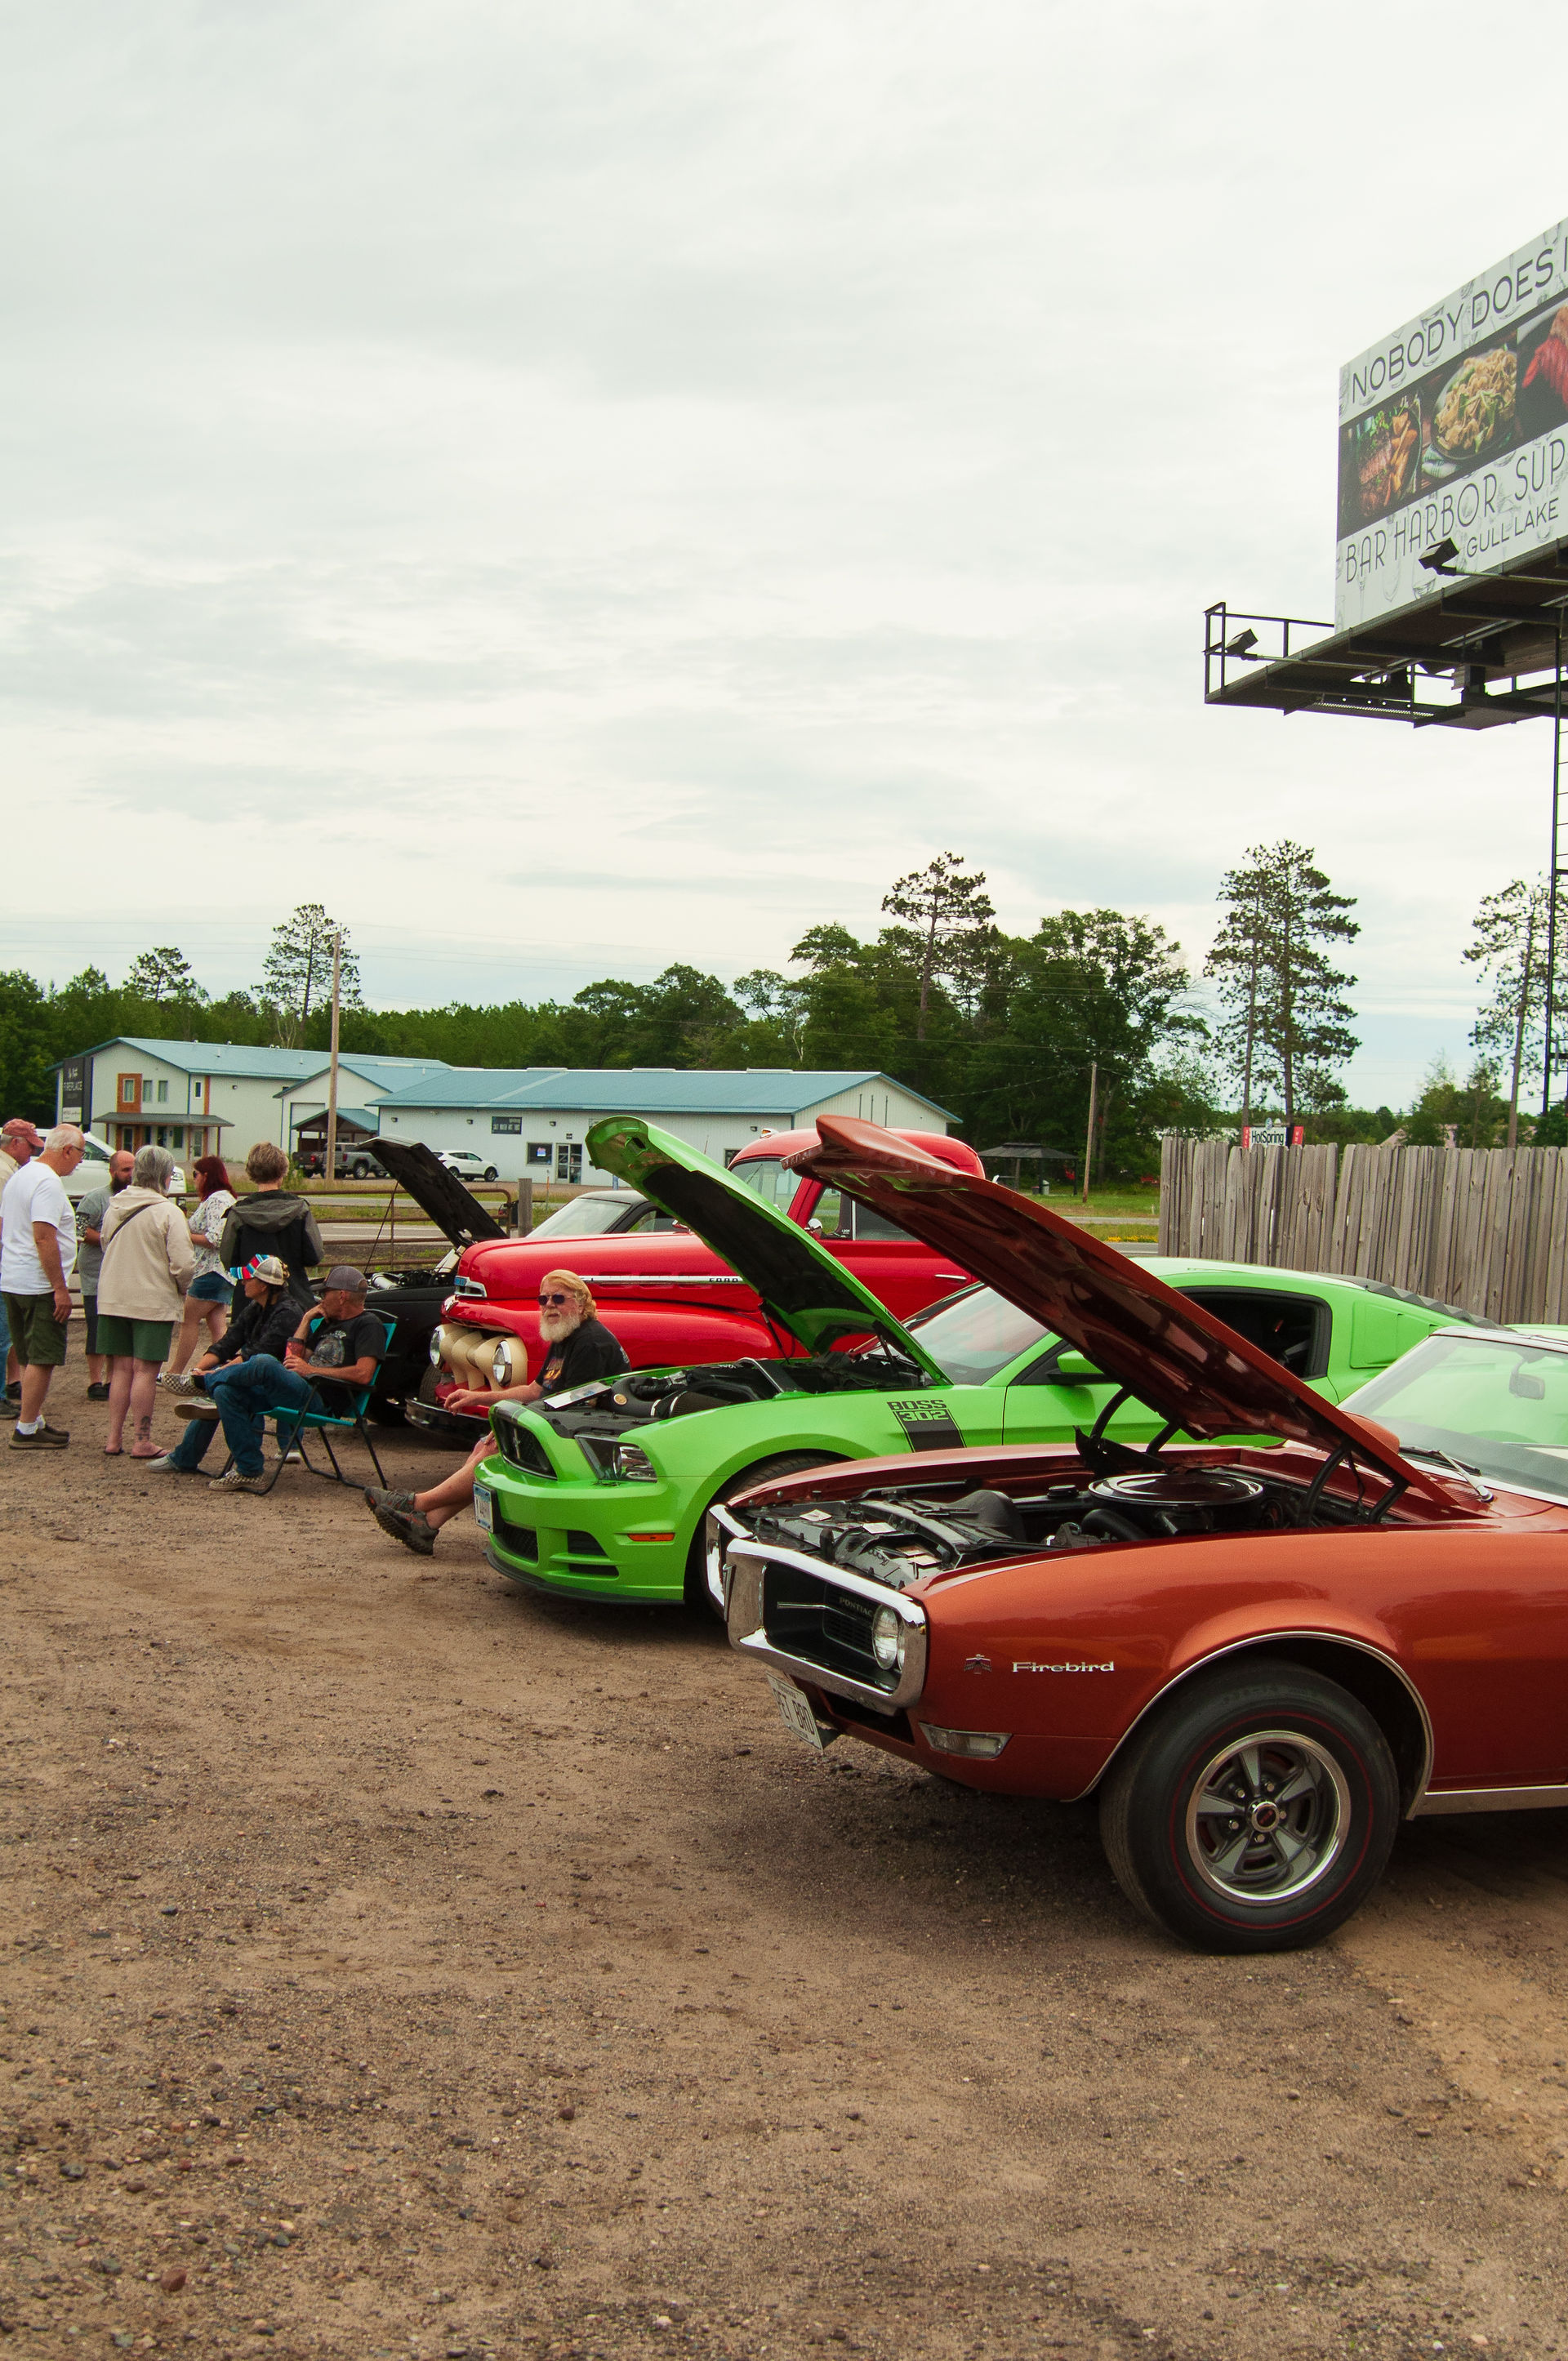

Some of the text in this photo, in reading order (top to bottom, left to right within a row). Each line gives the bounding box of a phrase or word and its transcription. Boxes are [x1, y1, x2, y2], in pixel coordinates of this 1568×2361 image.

[1352, 303, 1464, 403] NOBODY
[1471, 247, 1554, 330] DOES
[1345, 529, 1387, 583] BAR
[1393, 473, 1497, 561] HARBOR
[1467, 497, 1559, 558] GULL LAKE
[1251, 1129, 1285, 1147] HotSpring
[886, 1399, 947, 1410] BOSS
[898, 1410, 949, 1422] 302
[839, 1597, 874, 1617] PONTIAC
[1012, 1660, 1115, 1673] Firebird
